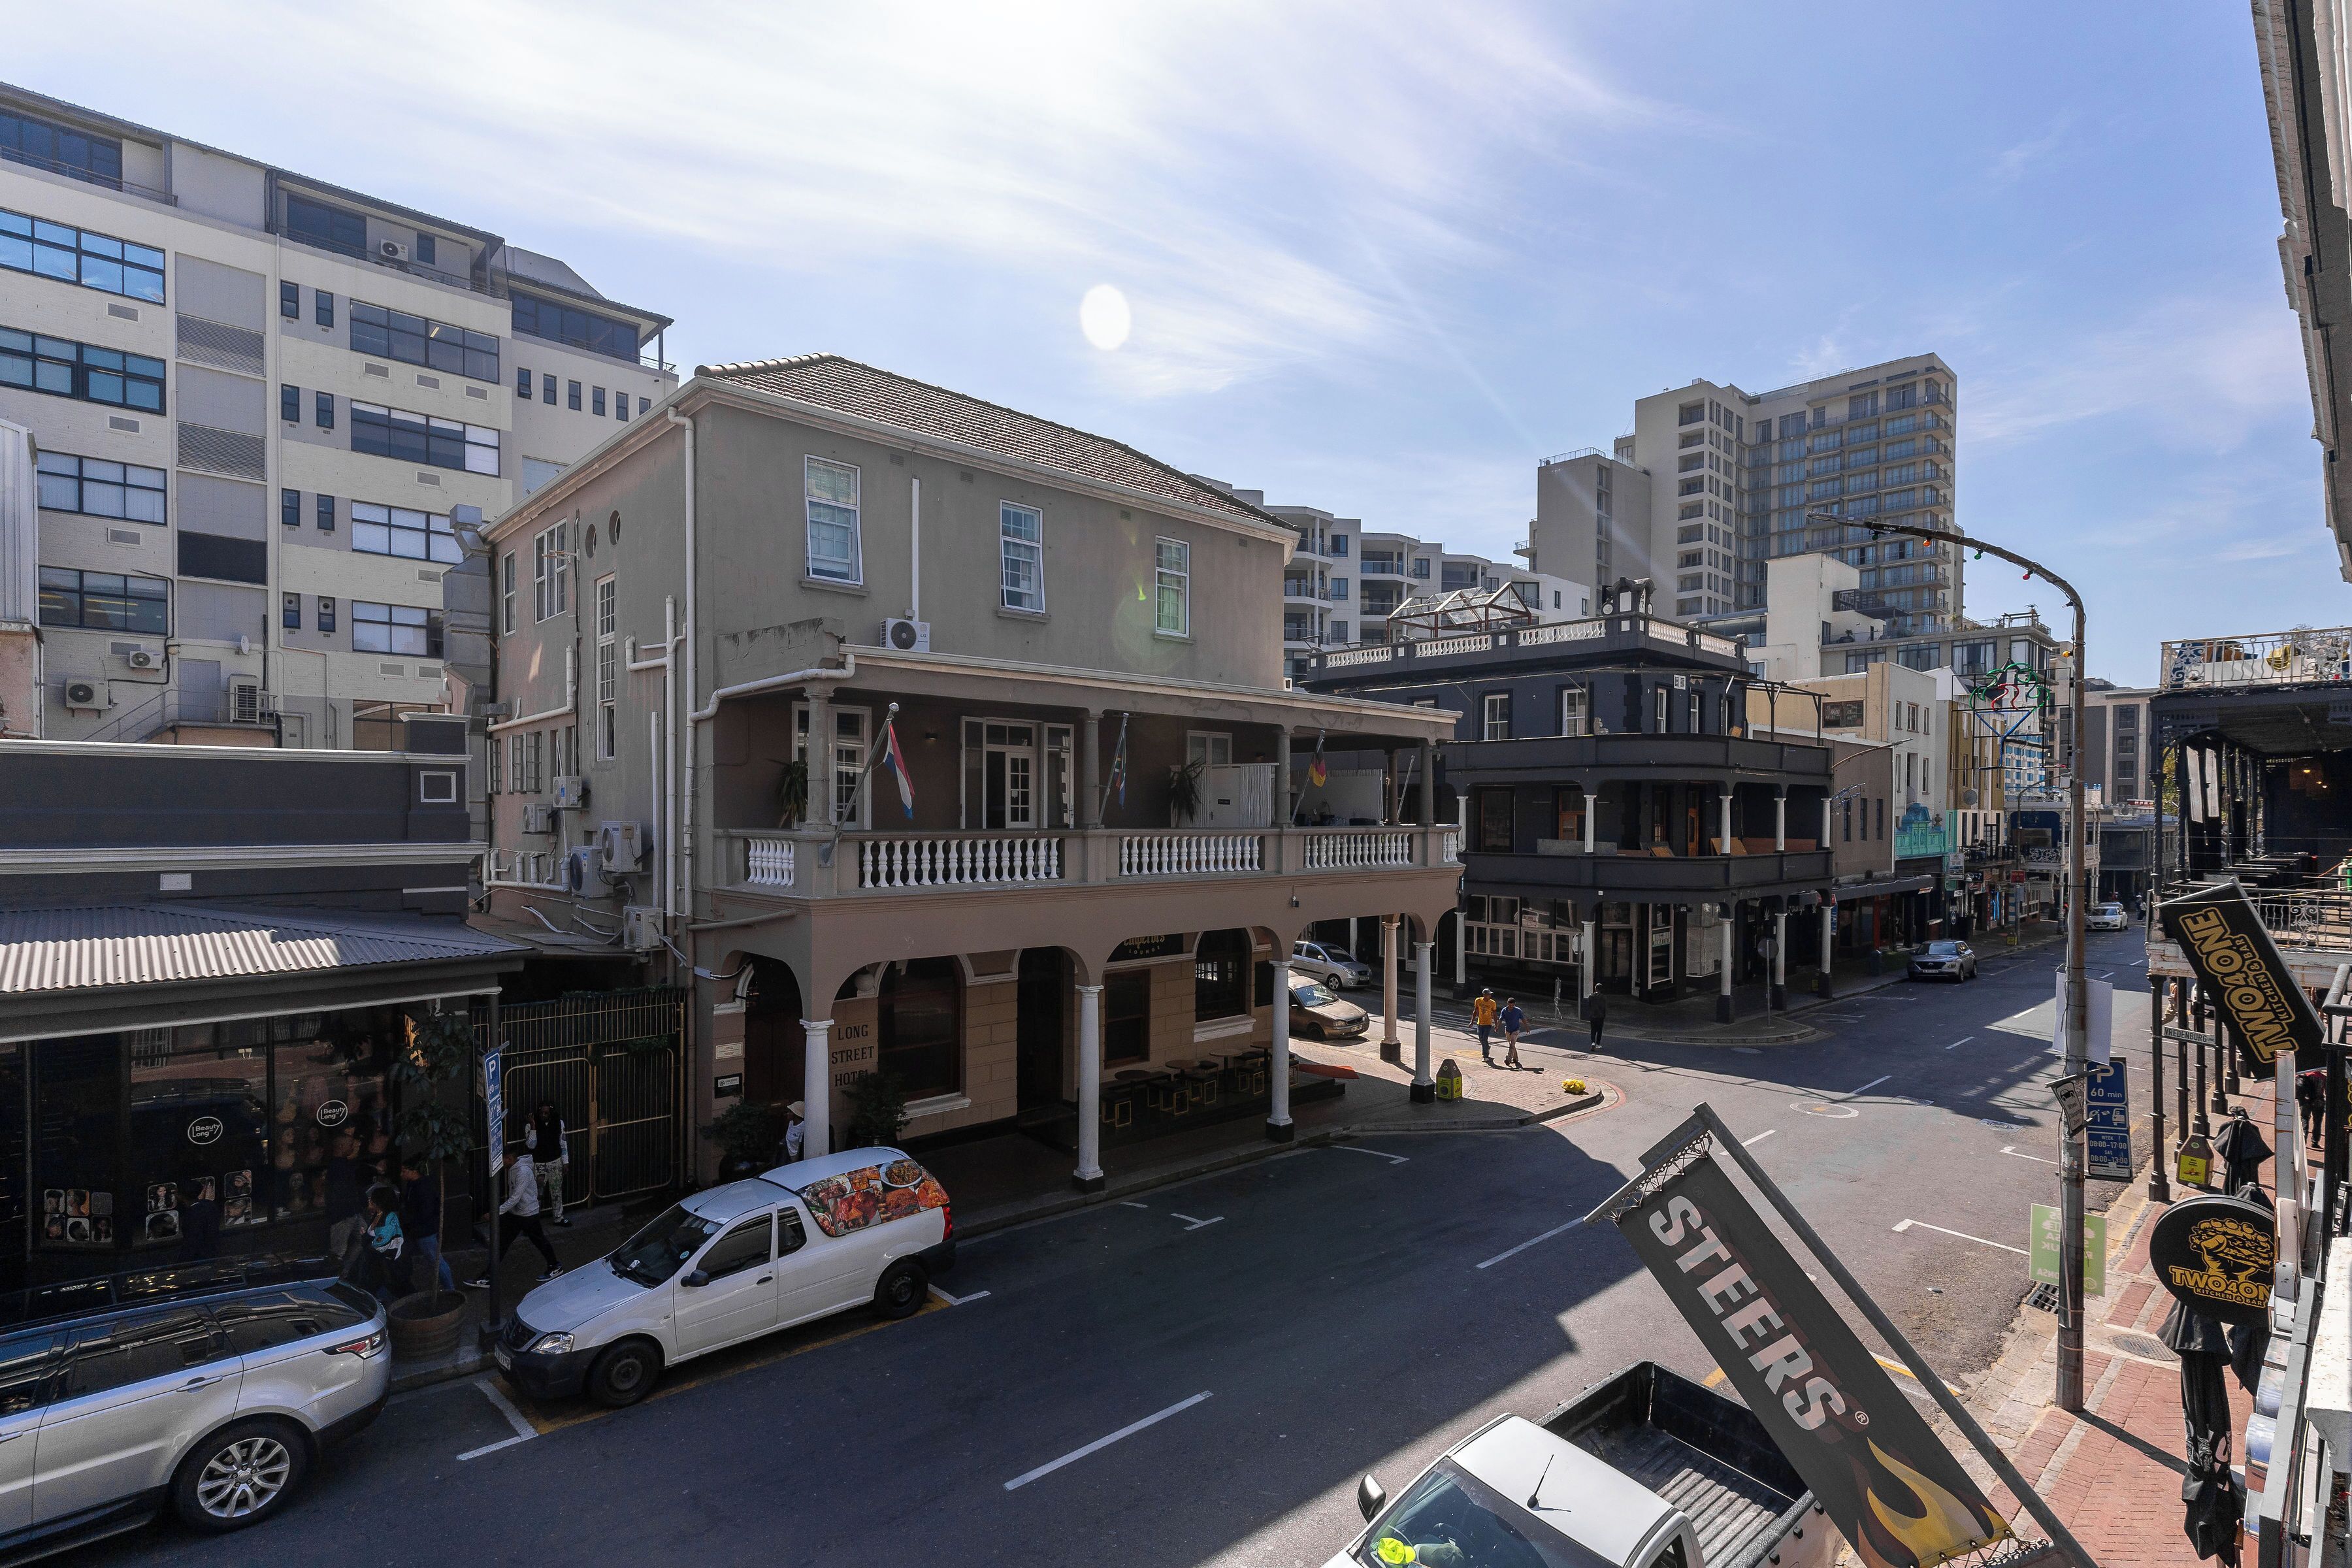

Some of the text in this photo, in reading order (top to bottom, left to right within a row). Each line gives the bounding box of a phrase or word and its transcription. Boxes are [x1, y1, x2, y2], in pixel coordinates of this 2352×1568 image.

[2234, 938, 2290, 1021] KITCHEN & BAR
[838, 1024, 868, 1040] LONG
[2164, 1027, 2207, 1043] VREDENBURG
[832, 1046, 874, 1064] STREET
[834, 1070, 868, 1086] HOT
[2091, 1088, 2104, 1097] 60
[320, 1109, 336, 1120] Long
[323, 1107, 346, 1117] Beauty
[192, 1126, 209, 1137] Long
[195, 1123, 220, 1134] Beauty
[2170, 1267, 2270, 1301] TWO4ON
[2197, 1288, 2232, 1299] KITCHEN
[1649, 1196, 1846, 1431] STEERS
